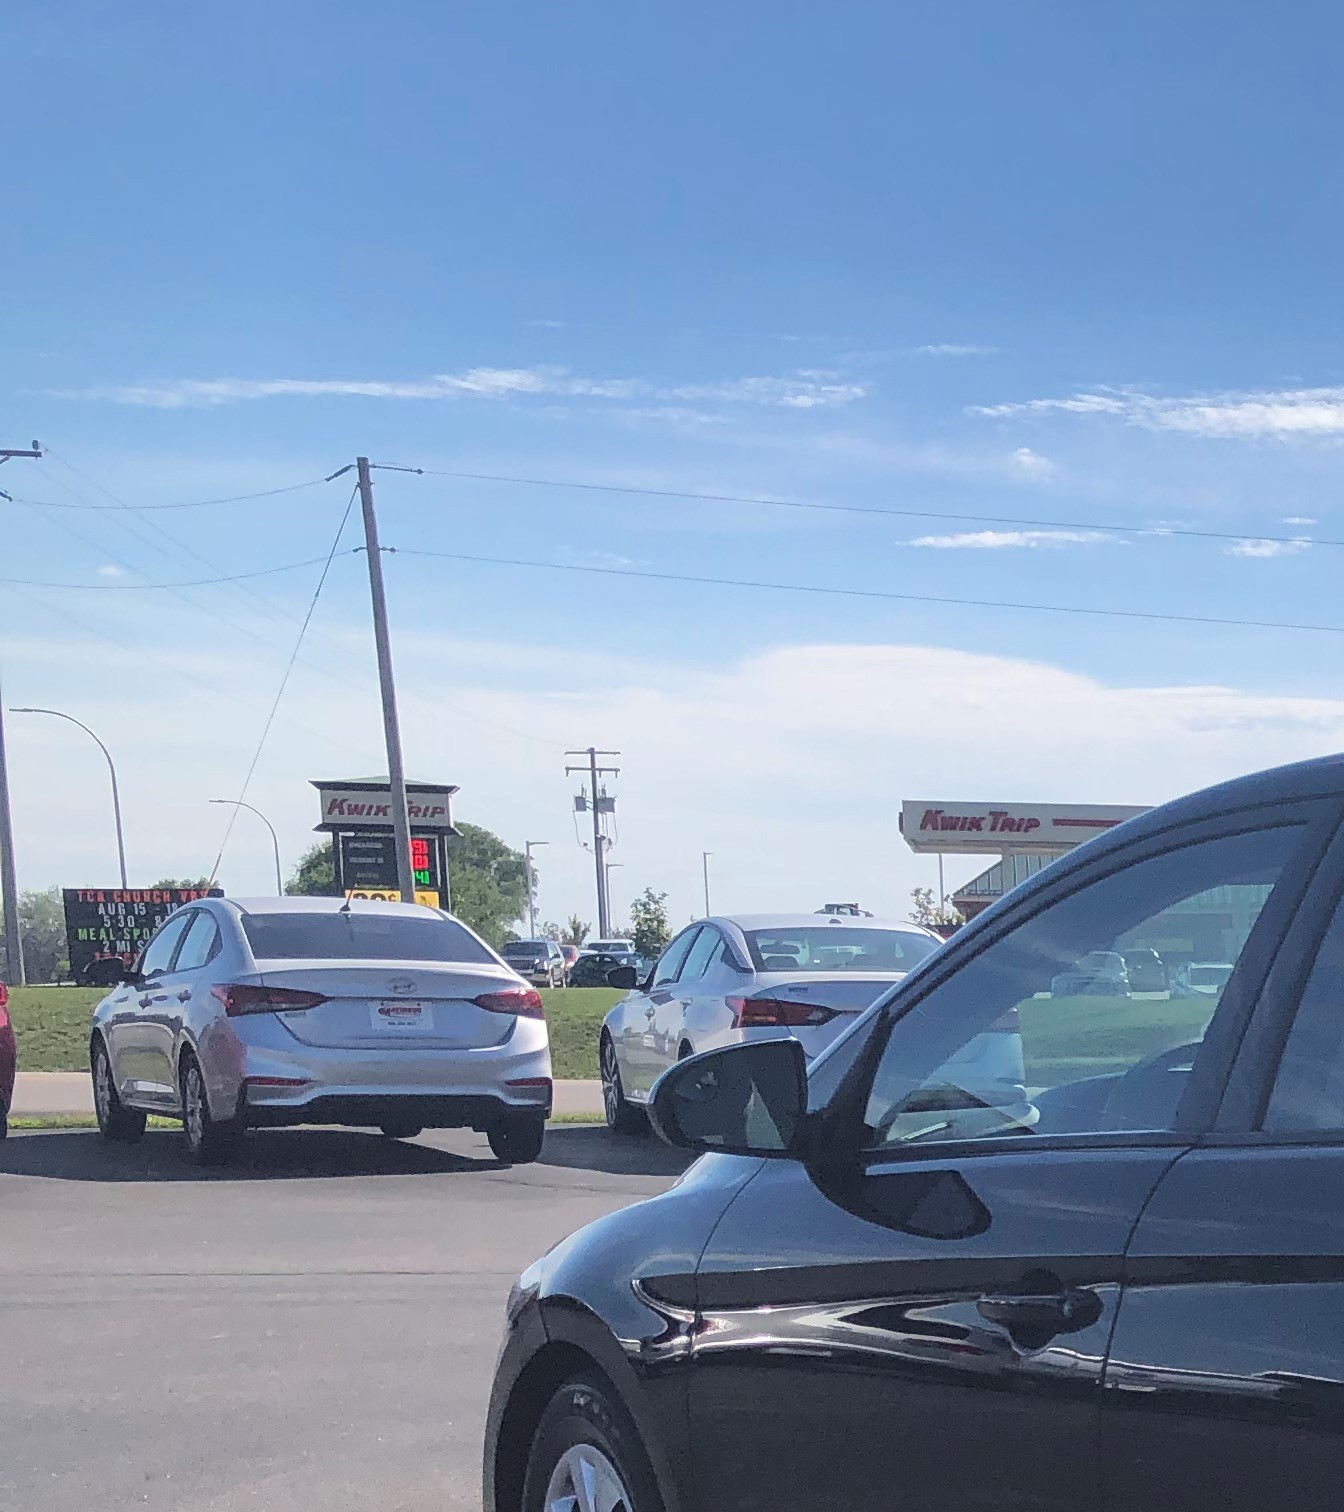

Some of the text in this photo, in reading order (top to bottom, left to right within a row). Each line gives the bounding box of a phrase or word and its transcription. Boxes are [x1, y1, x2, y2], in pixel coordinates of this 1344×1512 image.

[327, 798, 446, 818] KWIK RIP
[919, 809, 1041, 833] KWIK TRIP
[113, 890, 171, 903] CHURCH
[98, 902, 126, 915] AUG
[133, 902, 146, 915] 15
[77, 927, 116, 940] MEAL
